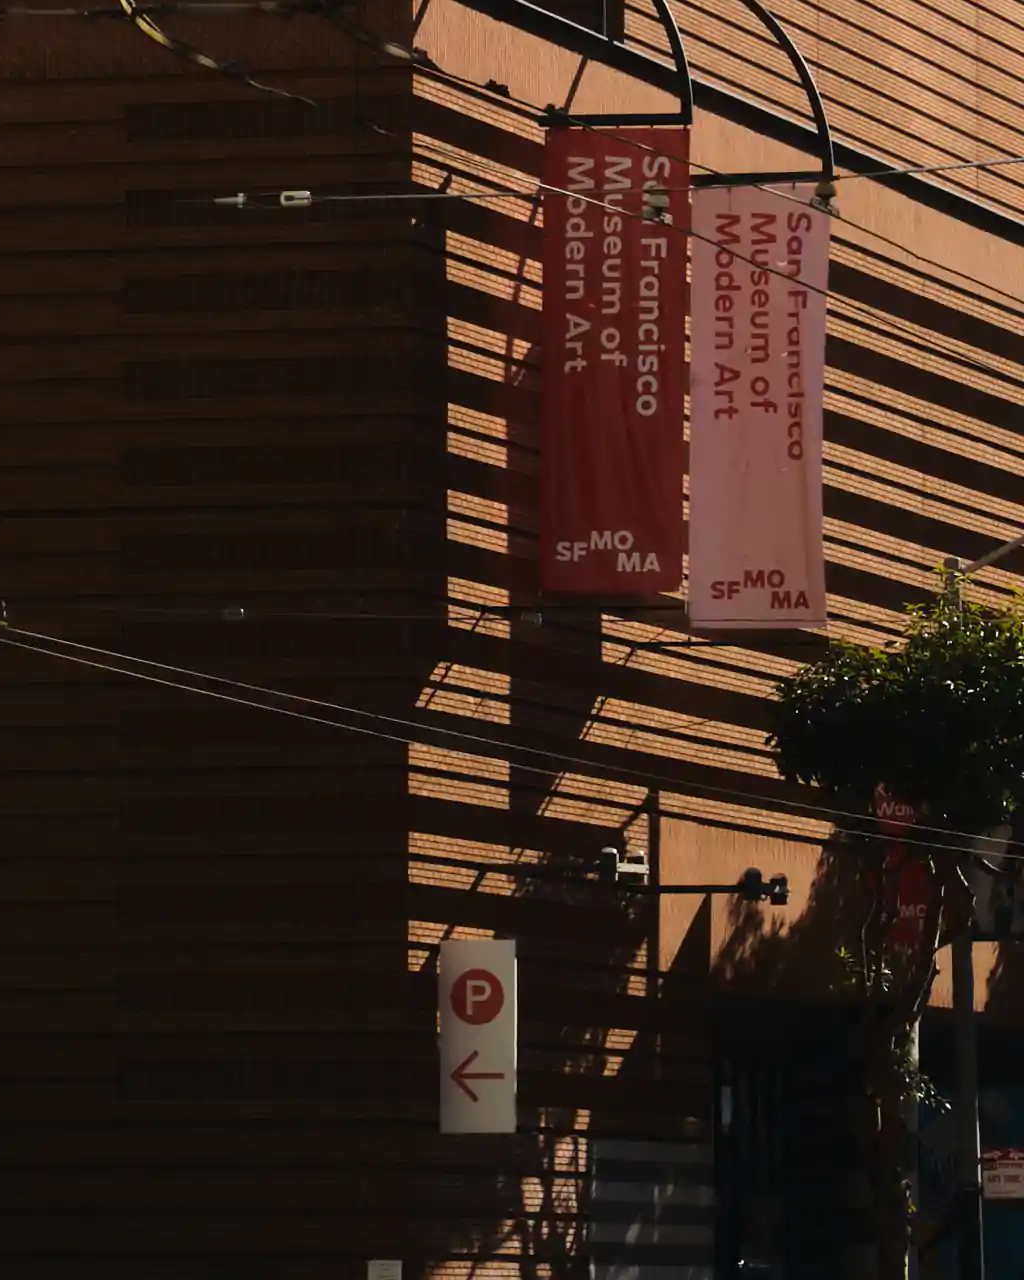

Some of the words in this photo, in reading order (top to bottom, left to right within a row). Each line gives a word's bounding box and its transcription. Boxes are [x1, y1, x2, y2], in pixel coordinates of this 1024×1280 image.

[565, 156, 594, 300] Modern
[601, 156, 632, 315] Museum
[787, 211, 813, 279] San
[636, 237, 668, 416] Francisco
[714, 213, 742, 350] Modern
[750, 213, 777, 364] Museum
[564, 314, 591, 374] Art
[600, 328, 627, 367] of
[713, 362, 741, 420] Art
[750, 376, 778, 414] of
[787, 290, 808, 461] Francisco
[465, 979, 492, 1016] P
